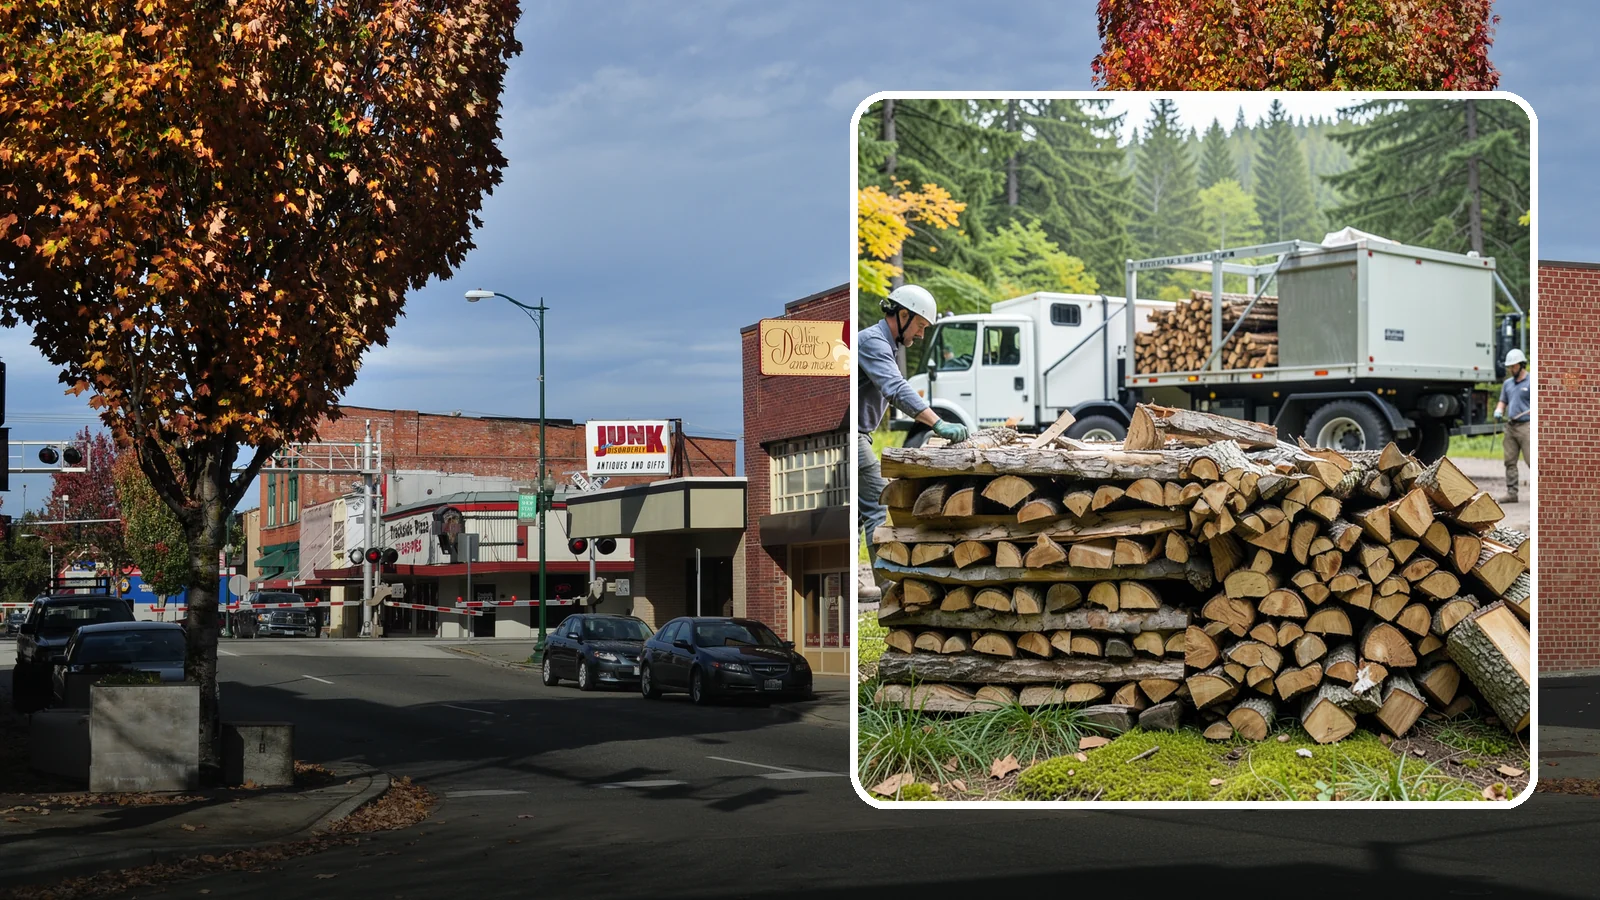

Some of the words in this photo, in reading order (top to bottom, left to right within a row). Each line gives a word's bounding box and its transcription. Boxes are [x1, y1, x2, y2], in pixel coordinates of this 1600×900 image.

[596, 425, 665, 457] JUNK
[607, 445, 646, 454] DISORDERLY
[597, 461, 628, 470] ANTIQUES
[631, 461, 644, 470] AND
[647, 461, 665, 469] GIFTS
[414, 519, 429, 535] Pizza
